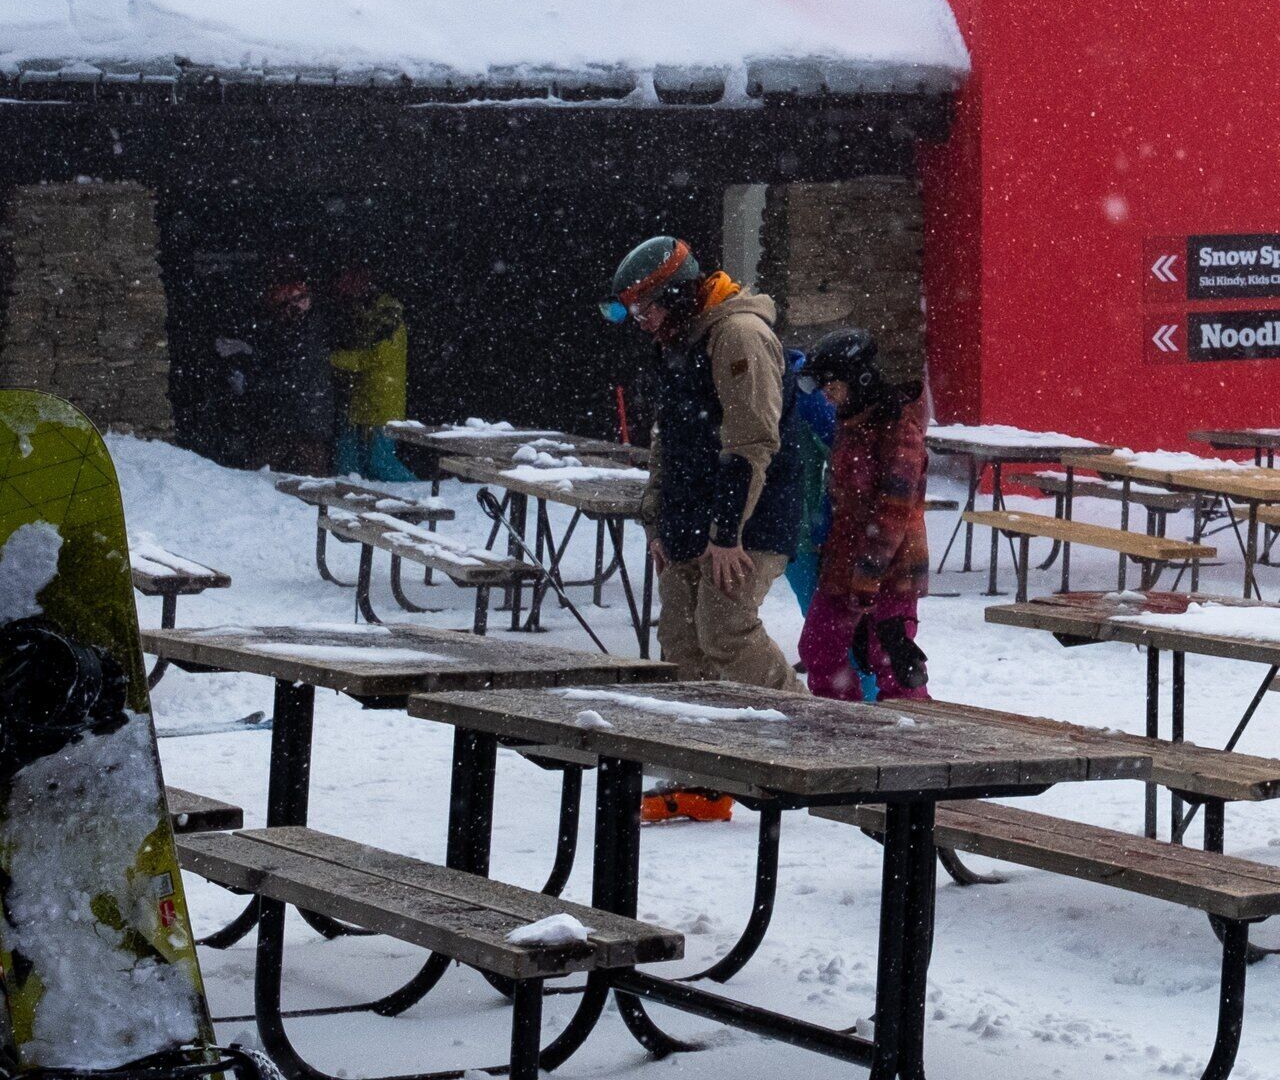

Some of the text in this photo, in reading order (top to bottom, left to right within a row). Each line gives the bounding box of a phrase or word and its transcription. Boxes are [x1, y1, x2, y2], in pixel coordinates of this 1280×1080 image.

[1199, 247, 1258, 267] Snow
[1199, 276, 1216, 287] Ski
[1217, 275, 1247, 287] Kindy,
[1248, 274, 1270, 285] Kids
